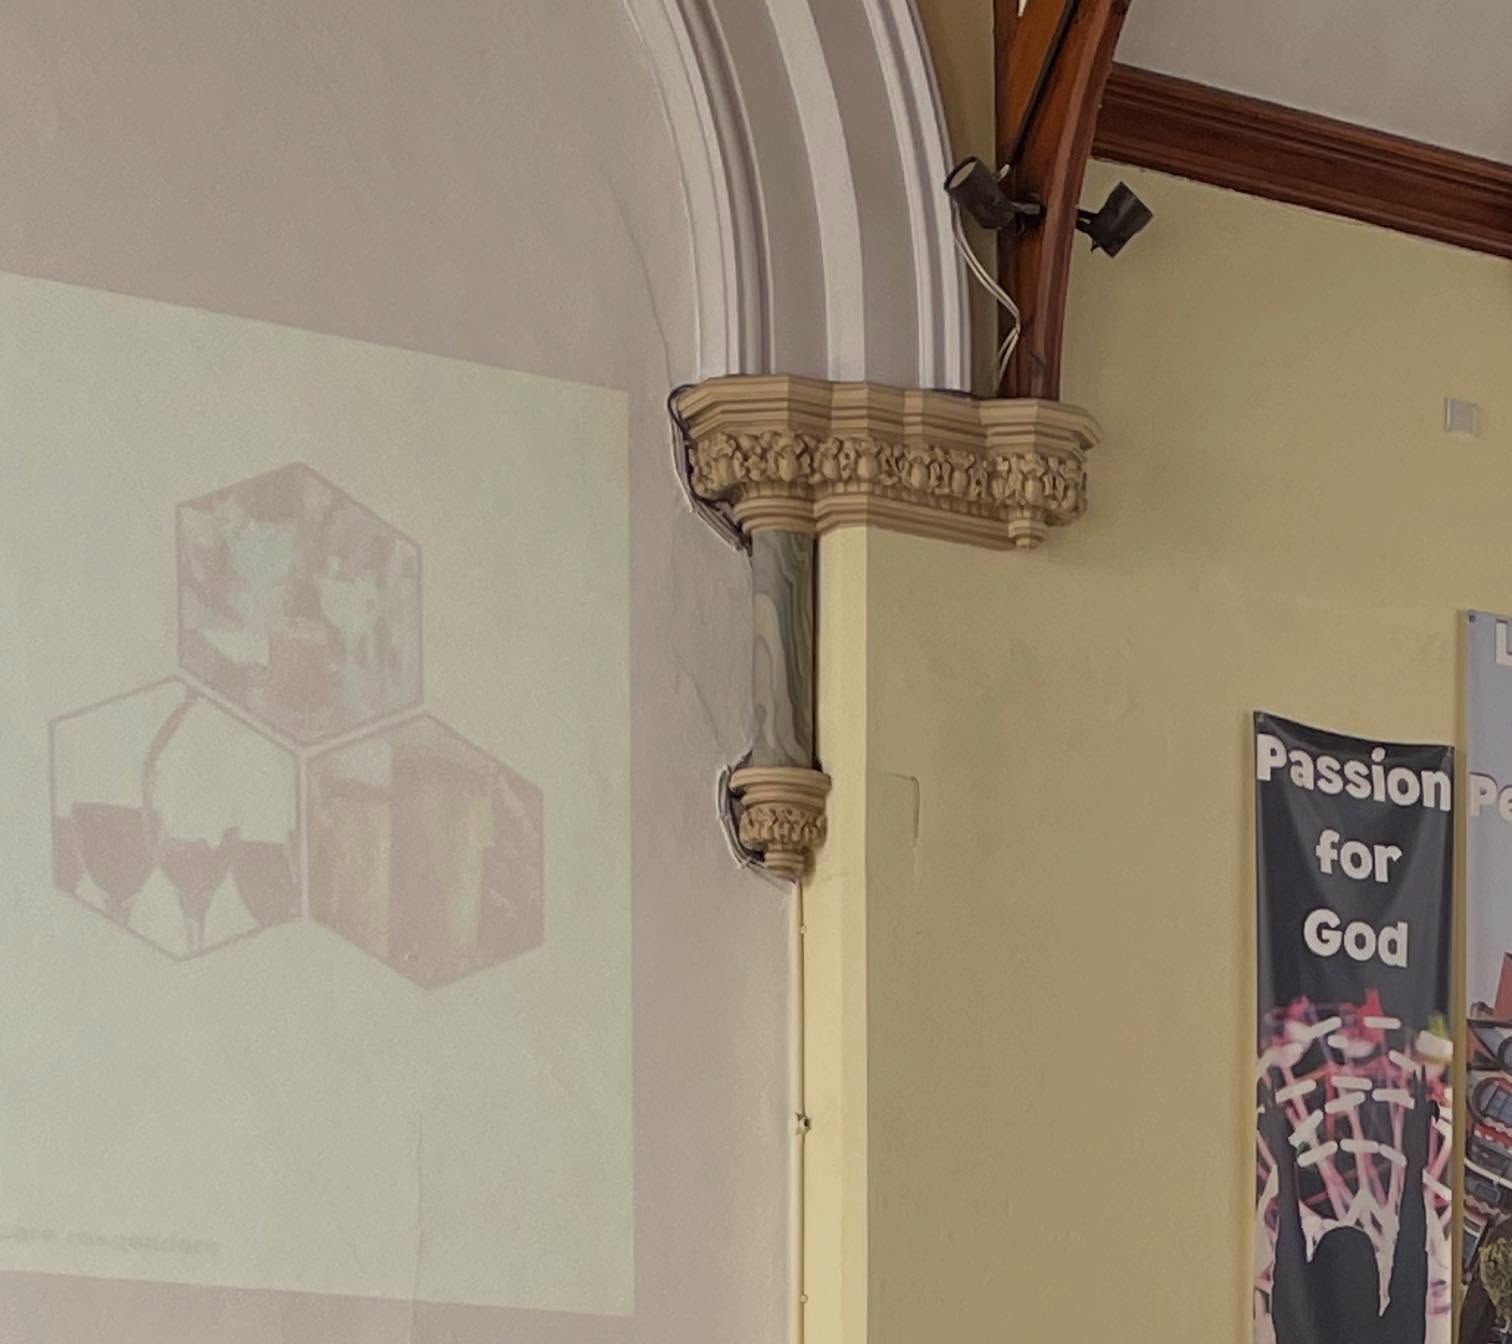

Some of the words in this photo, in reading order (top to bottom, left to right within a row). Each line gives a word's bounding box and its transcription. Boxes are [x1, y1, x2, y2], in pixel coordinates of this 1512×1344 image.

[1256, 733, 1452, 812] Passion
[1315, 829, 1403, 883] for
[1303, 908, 1409, 969] God
